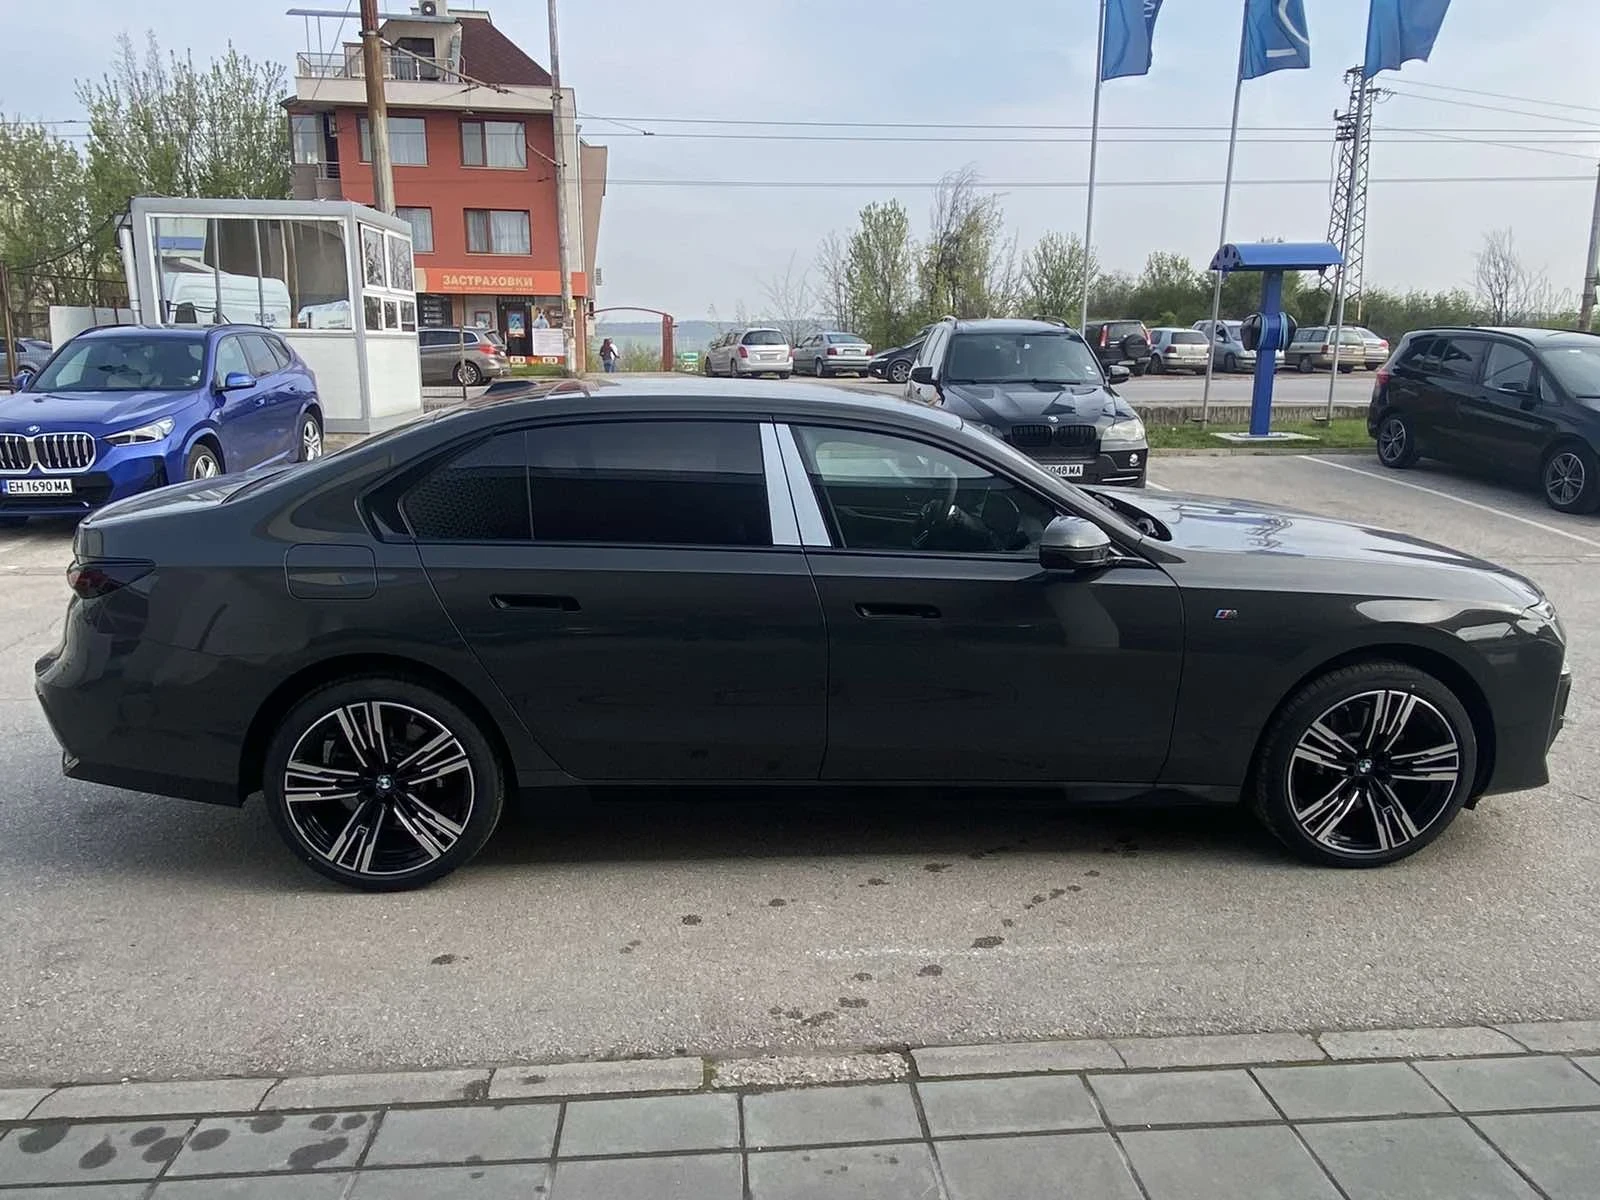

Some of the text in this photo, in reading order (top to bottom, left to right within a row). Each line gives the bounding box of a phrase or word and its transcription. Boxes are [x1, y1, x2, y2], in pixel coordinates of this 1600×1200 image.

[443, 274, 533, 288] ЗАСТРАХОВКИ
[1045, 466, 1081, 475] 048 MA
[8, 481, 70, 492] EH 1690 MA
